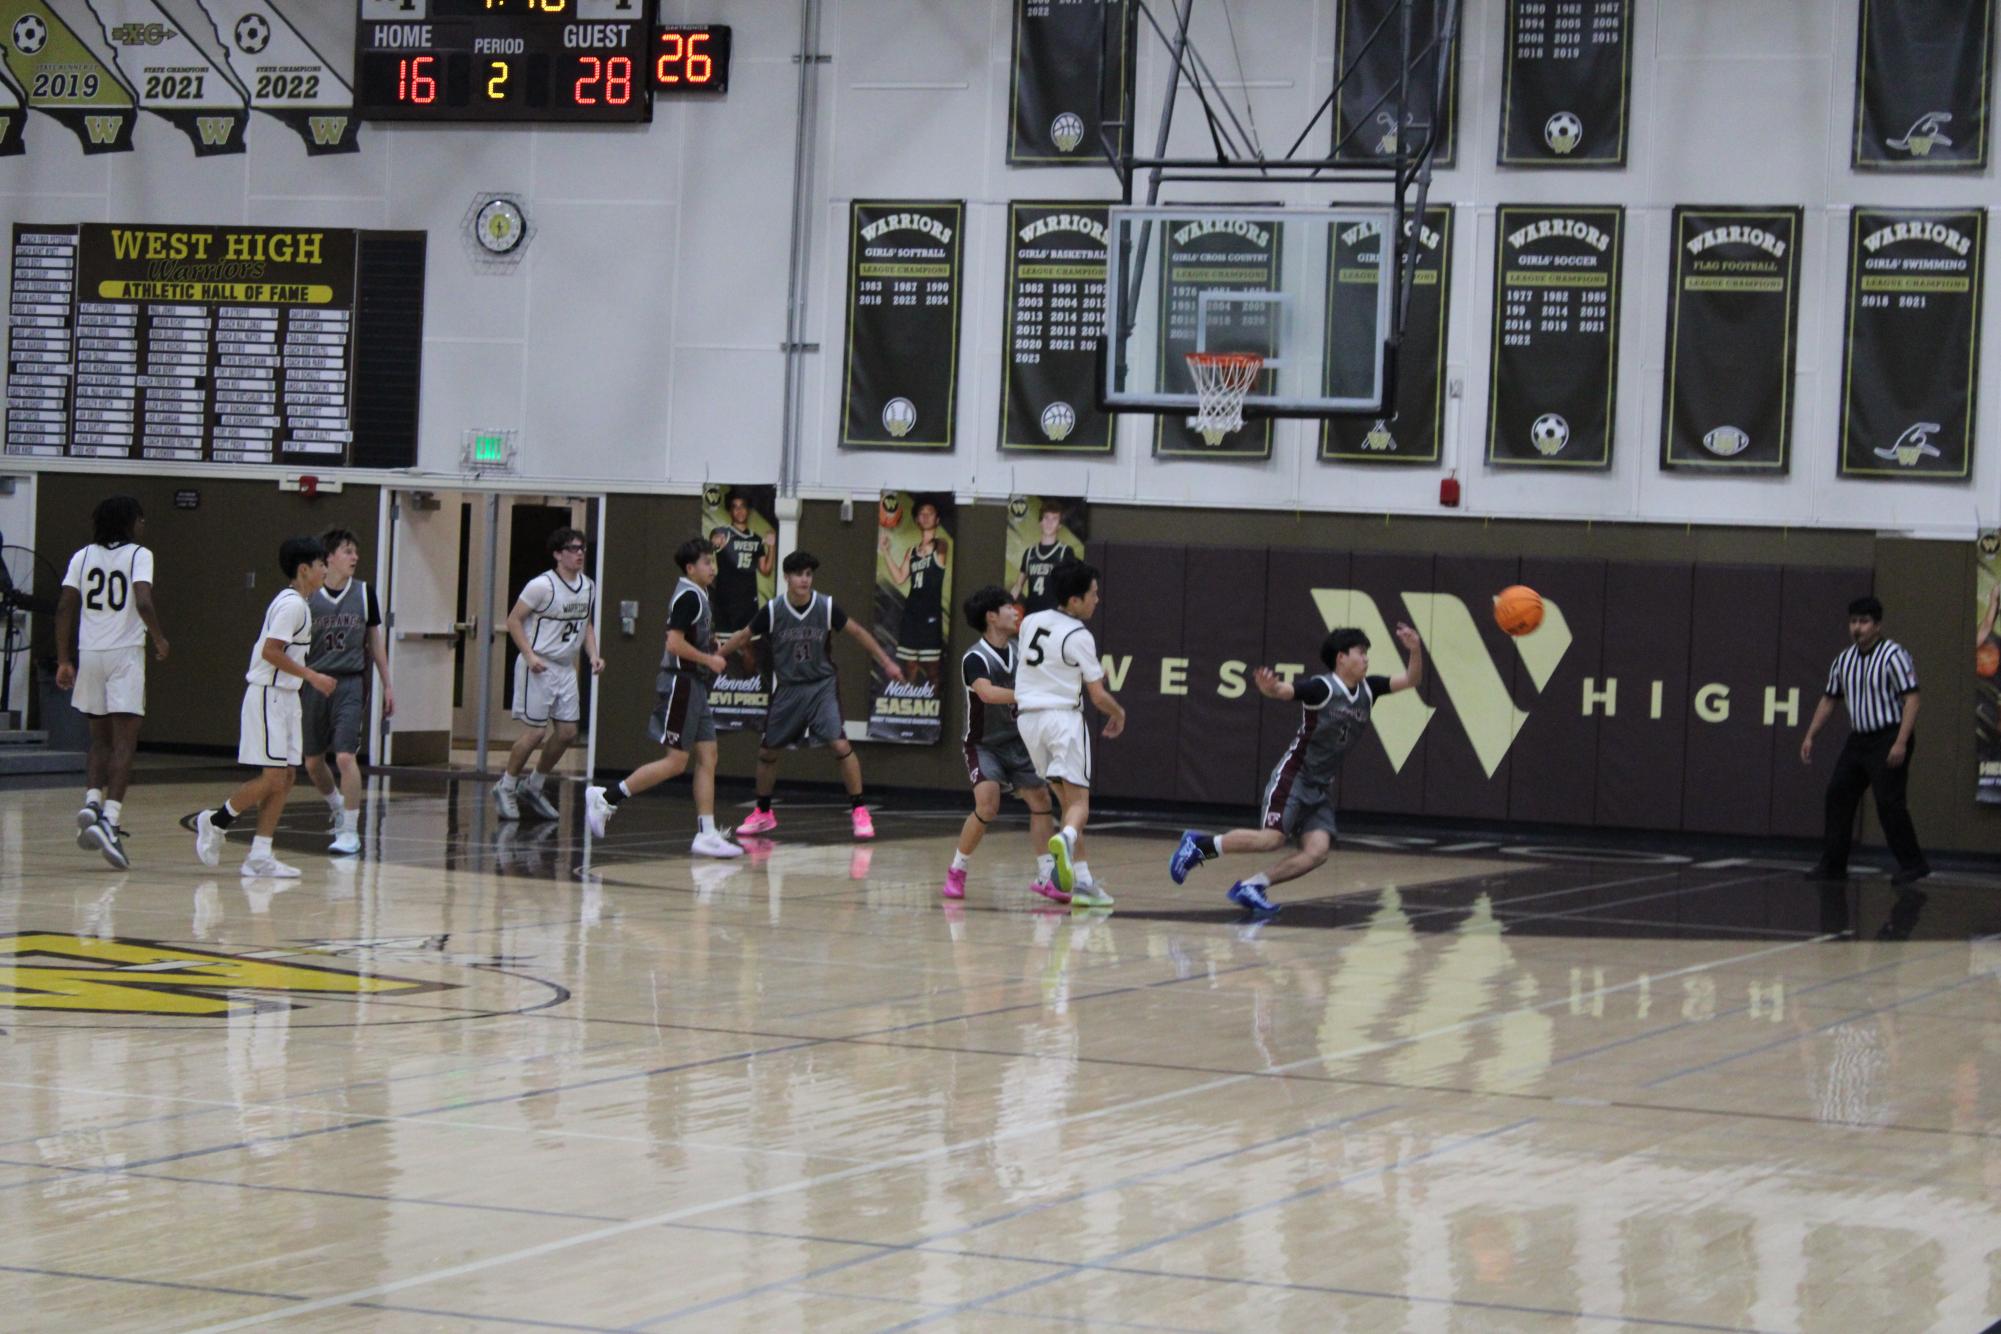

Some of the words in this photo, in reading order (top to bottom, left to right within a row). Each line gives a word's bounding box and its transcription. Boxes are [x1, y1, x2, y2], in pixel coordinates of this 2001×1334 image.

[374, 25, 432, 47] HOME
[474, 38, 524, 54] PERIOD
[563, 24, 631, 48] GUEST
[657, 33, 712, 82] 26
[256, 65, 278, 73] STATE
[279, 65, 322, 73] CHAMPIONS
[33, 73, 99, 97] 2019
[145, 76, 205, 99] 2021
[256, 75, 320, 99] 2022
[399, 57, 436, 103] 16
[487, 61, 508, 99] 2
[574, 56, 632, 104] 28
[84, 116, 123, 144] W
[196, 117, 235, 144] W
[308, 117, 348, 144] W
[861, 213, 953, 244] WARRIORS
[1508, 218, 1610, 251] WARRIORS
[1863, 221, 1971, 255] WARRIORS
[112, 229, 213, 260] WEST
[224, 233, 323, 264] HIGH
[1686, 225, 1786, 258] WARRIORS
[865, 247, 897, 257] GIRLS'
[898, 248, 946, 258] SOFTBALL
[1018, 249, 1049, 259] GIRLS'
[1050, 249, 1107, 259] BASKETBAL
[1518, 255, 1553, 266] GIRLS'
[1554, 255, 1598, 266] SOCCER
[149, 257, 266, 282] Warriors
[1056, 268, 1106, 276] CHAMPION
[1722, 261, 1778, 271] FOOTBALL
[1865, 258, 1901, 270] GIRLS'
[1902, 258, 1968, 271] SWIMMING
[122, 282, 195, 299] ATHLETIC
[201, 285, 238, 300] HALL
[244, 285, 264, 300] OF
[269, 286, 309, 302] FAME
[1507, 290, 1533, 301] 1977
[1898, 295, 1926, 309] 2021
[1050, 311, 1077, 322] 2014
[1542, 305, 1569, 317] 2014
[1016, 325, 1042, 335] 2017
[1579, 321, 1605, 333] 2021
[1049, 340, 1075, 350] 2021
[475, 437, 502, 460] EXIT
[733, 540, 760, 552] WEST
[736, 552, 753, 569] 15
[1029, 563, 1054, 576] WEST
[85, 567, 128, 611] 20
[1033, 576, 1045, 596] 4
[1026, 627, 1051, 667] 5
[713, 674, 762, 691] Kenneth
[884, 680, 935, 698] Natsuki
[1100, 654, 1305, 698] WEST
[1581, 677, 1799, 727] HIGH
[875, 697, 940, 716] SASAKI
